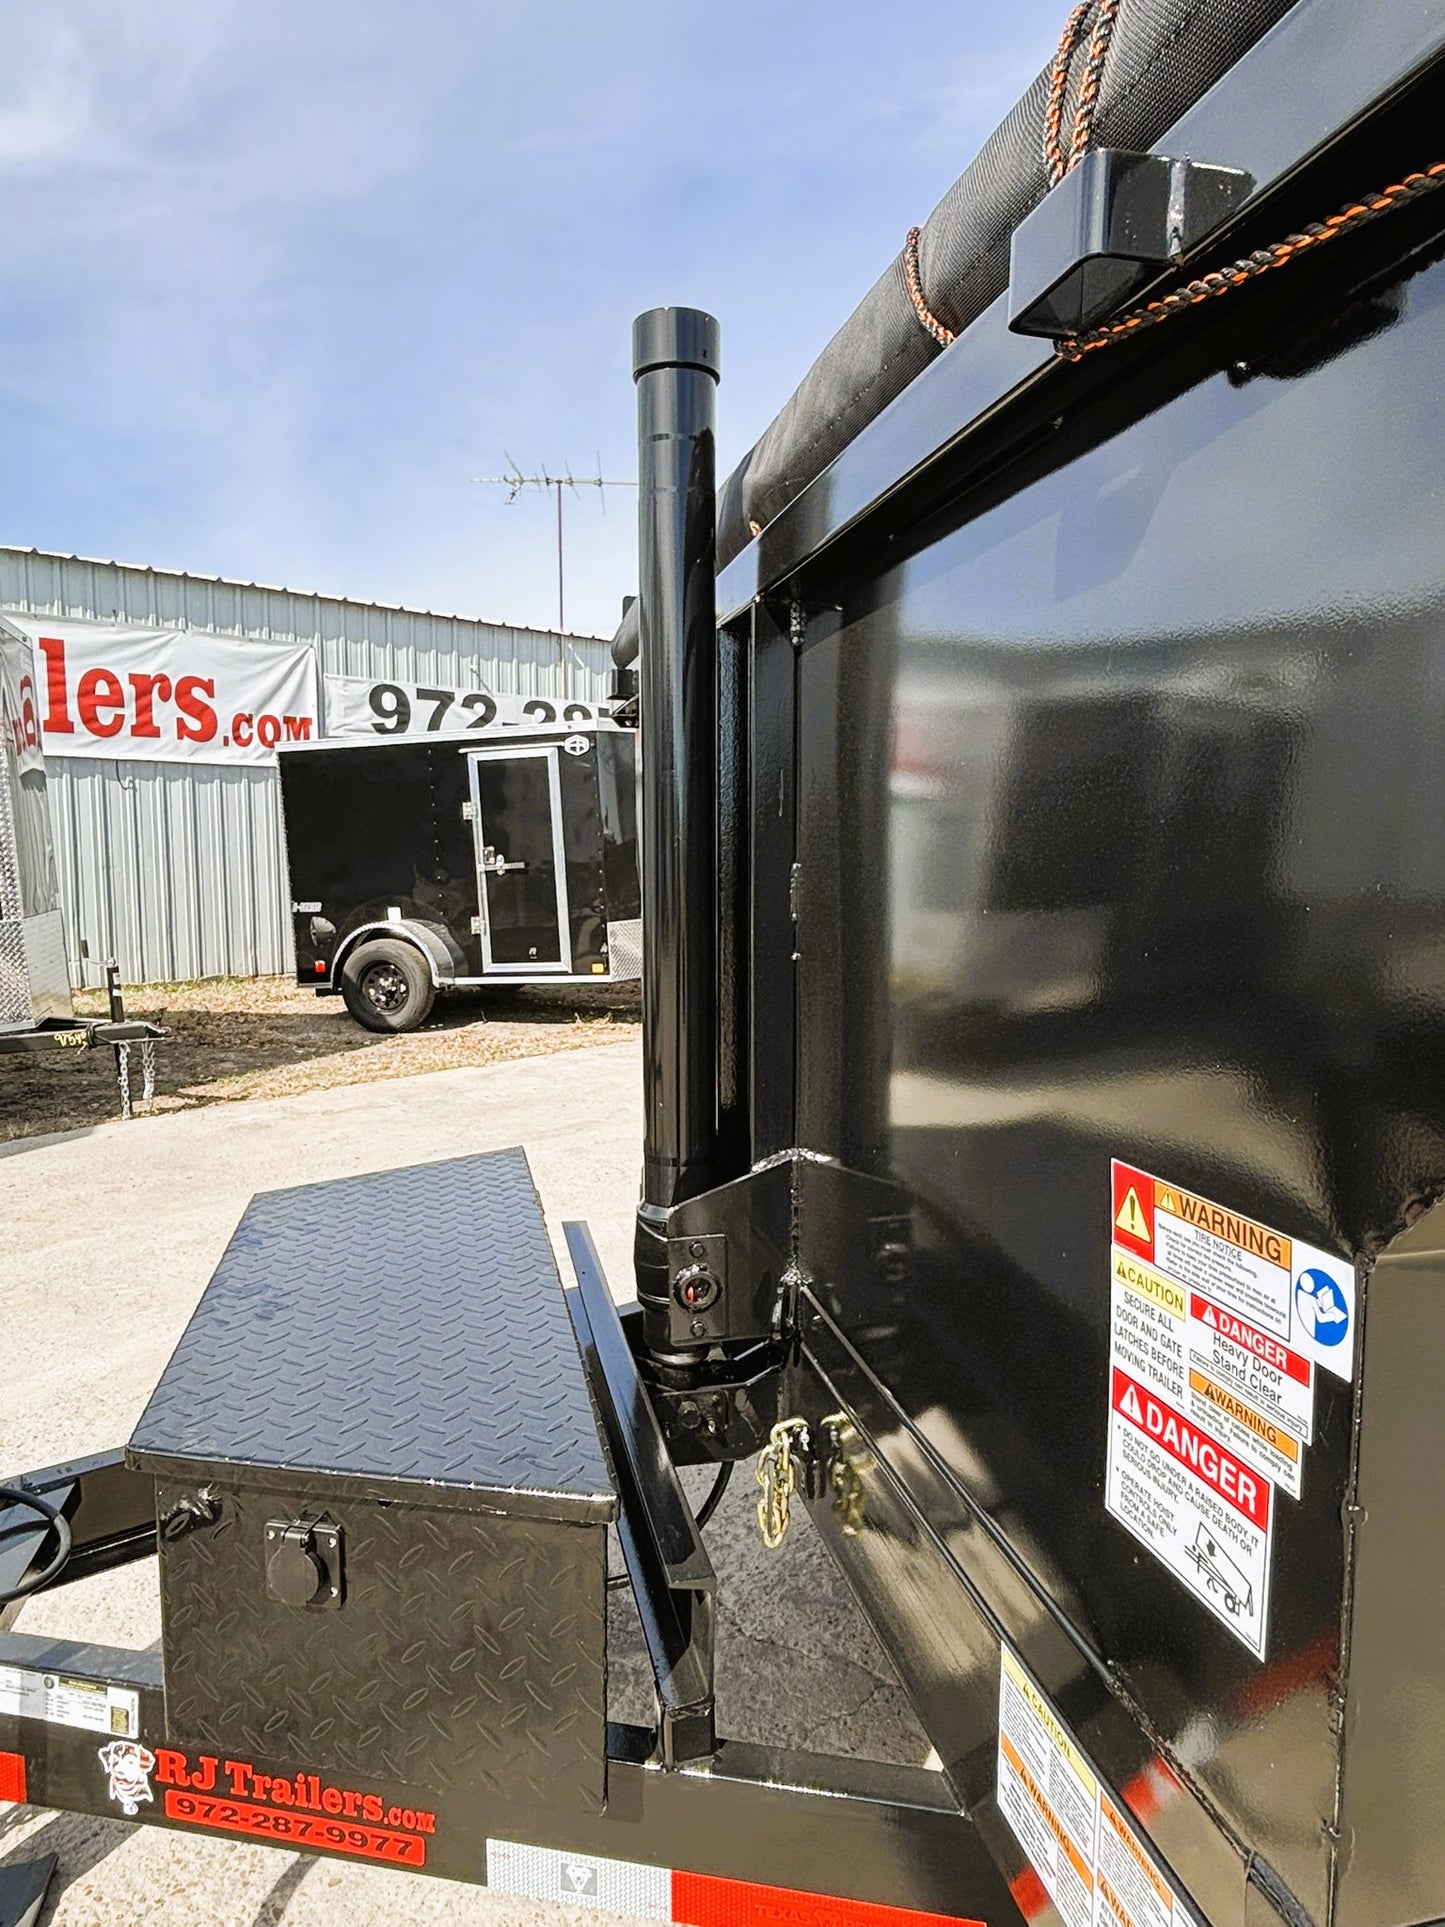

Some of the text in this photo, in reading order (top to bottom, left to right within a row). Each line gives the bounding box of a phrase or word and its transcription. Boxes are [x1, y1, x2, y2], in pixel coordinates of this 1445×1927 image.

[1180, 1194, 1281, 1263] WARNING
[1194, 1229, 1242, 1261] TIRE NOTICE
[1124, 1291, 1174, 1333] SECURE ALL
[1127, 1267, 1183, 1312] CAUTION
[1114, 1323, 1184, 1380] LATCHES BEFORE
[1116, 1305, 1182, 1358] DOOR AND GATE
[1213, 1332, 1282, 1386] Heavy Door
[1220, 1313, 1287, 1370] DANGER
[1114, 1341, 1183, 1400] MOVING TRAILER
[1213, 1350, 1282, 1404] Stand Clear
[1214, 1389, 1276, 1444] WARNING
[1122, 1448, 1151, 1480] SERIOUS
[1147, 1399, 1257, 1515] DANGER
[1120, 1478, 1176, 1537] CONTROLS ONLY
[1120, 1489, 1164, 1538] FROM A SAFE
[1121, 1468, 1173, 1523] OPERATE HOIST
[1122, 1426, 1132, 1442] DO
[1134, 1436, 1147, 1454] NOT
[1149, 1448, 1160, 1465] GO
[1162, 1459, 1186, 1486] UNDER
[1188, 1481, 1193, 1492] A
[1195, 1486, 1223, 1518] RAISED
[1251, 1534, 1258, 1549] IT
[1122, 1437, 1251, 1557] COULD DROP AND CAUSE DEATH OR
[1032, 1694, 1070, 1757] CAUTION
[154, 1748, 218, 1790] RJ
[176, 1797, 412, 1856] 972-287-9977
[1030, 1778, 1070, 1852] WARNING
[1119, 1820, 1160, 1890] WARNING
